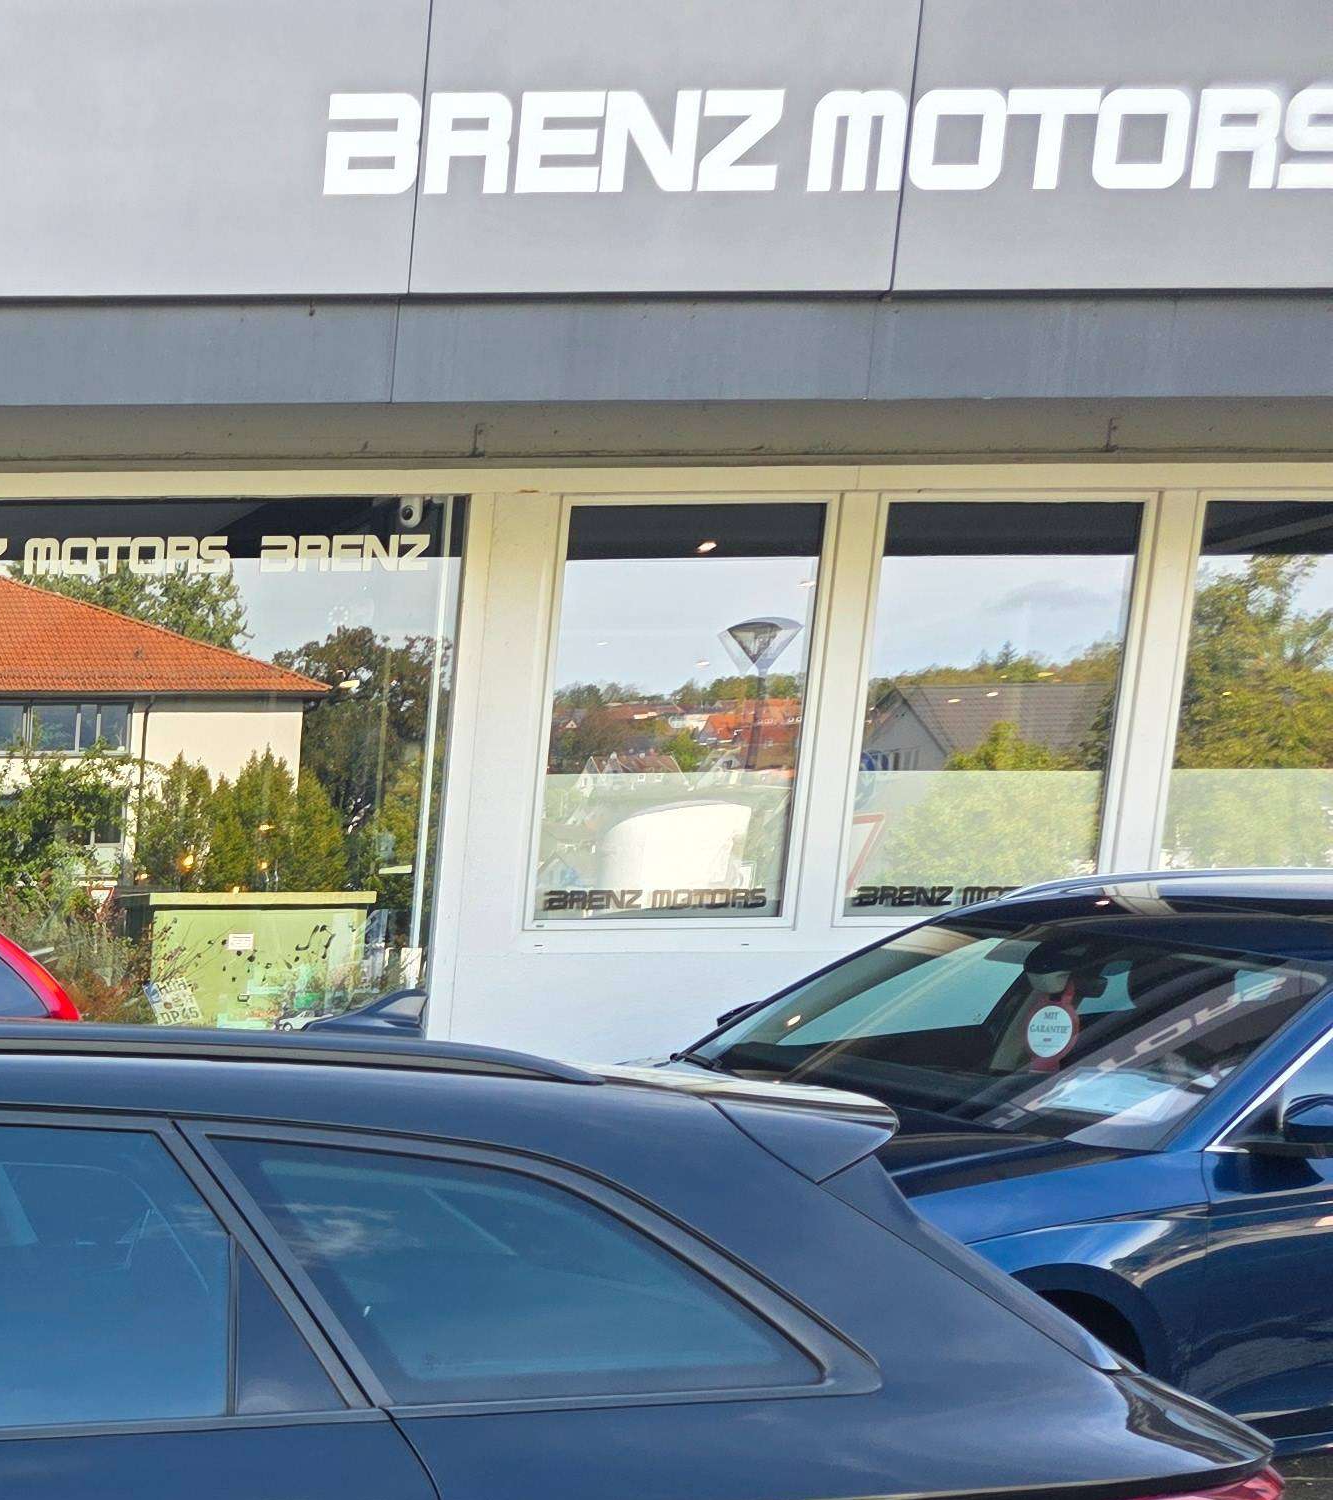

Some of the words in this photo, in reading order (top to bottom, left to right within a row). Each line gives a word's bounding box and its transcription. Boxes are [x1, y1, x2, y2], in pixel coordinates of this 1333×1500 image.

[323, 89, 785, 195] BRENZ
[807, 88, 1333, 191] MOTORS
[24, 537, 233, 577] MOTORS
[259, 535, 430, 573] BRENZ
[544, 888, 642, 910] BRENZ
[652, 888, 767, 909] MOTORS
[852, 886, 953, 906] BRENZ
